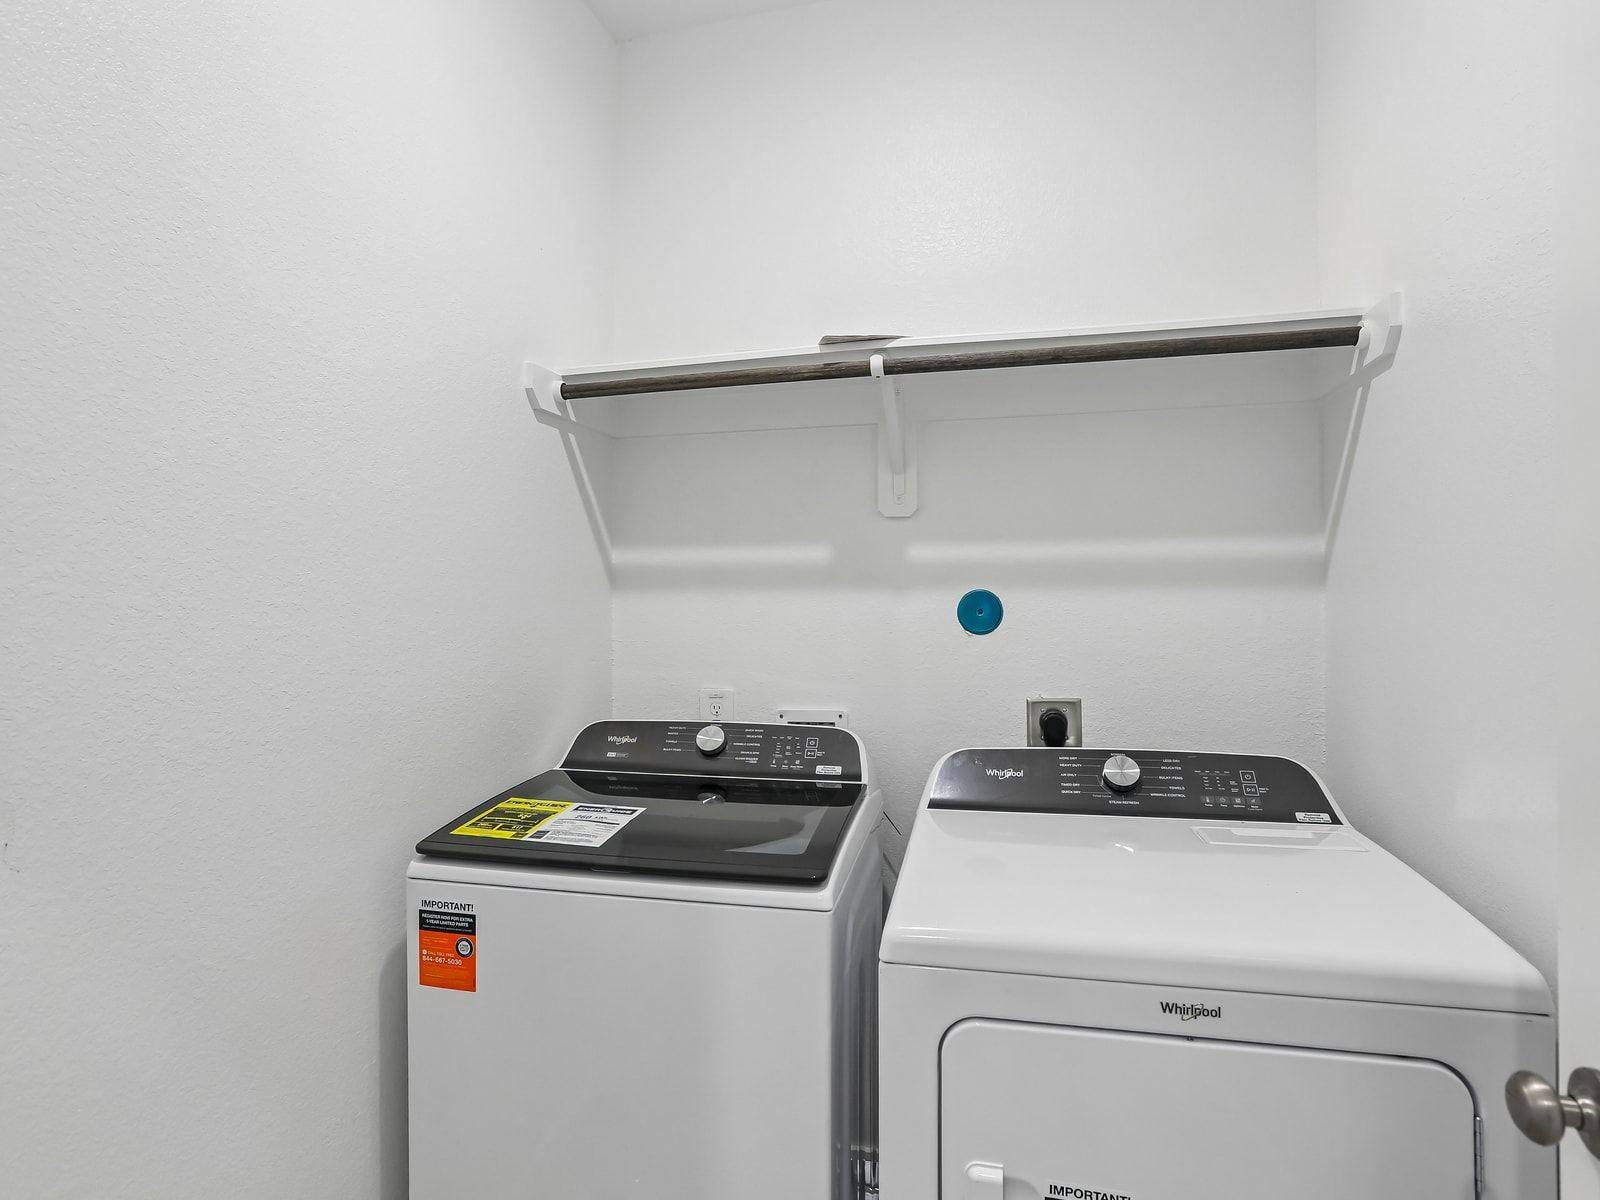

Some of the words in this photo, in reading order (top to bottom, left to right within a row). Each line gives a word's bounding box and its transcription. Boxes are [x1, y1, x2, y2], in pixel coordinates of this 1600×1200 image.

[607, 735, 638, 745] Whirlpool
[985, 768, 1024, 780] Whirlpool
[421, 899, 474, 912] IMPORTANT!
[1159, 1001, 1221, 1021] Whirlpool
